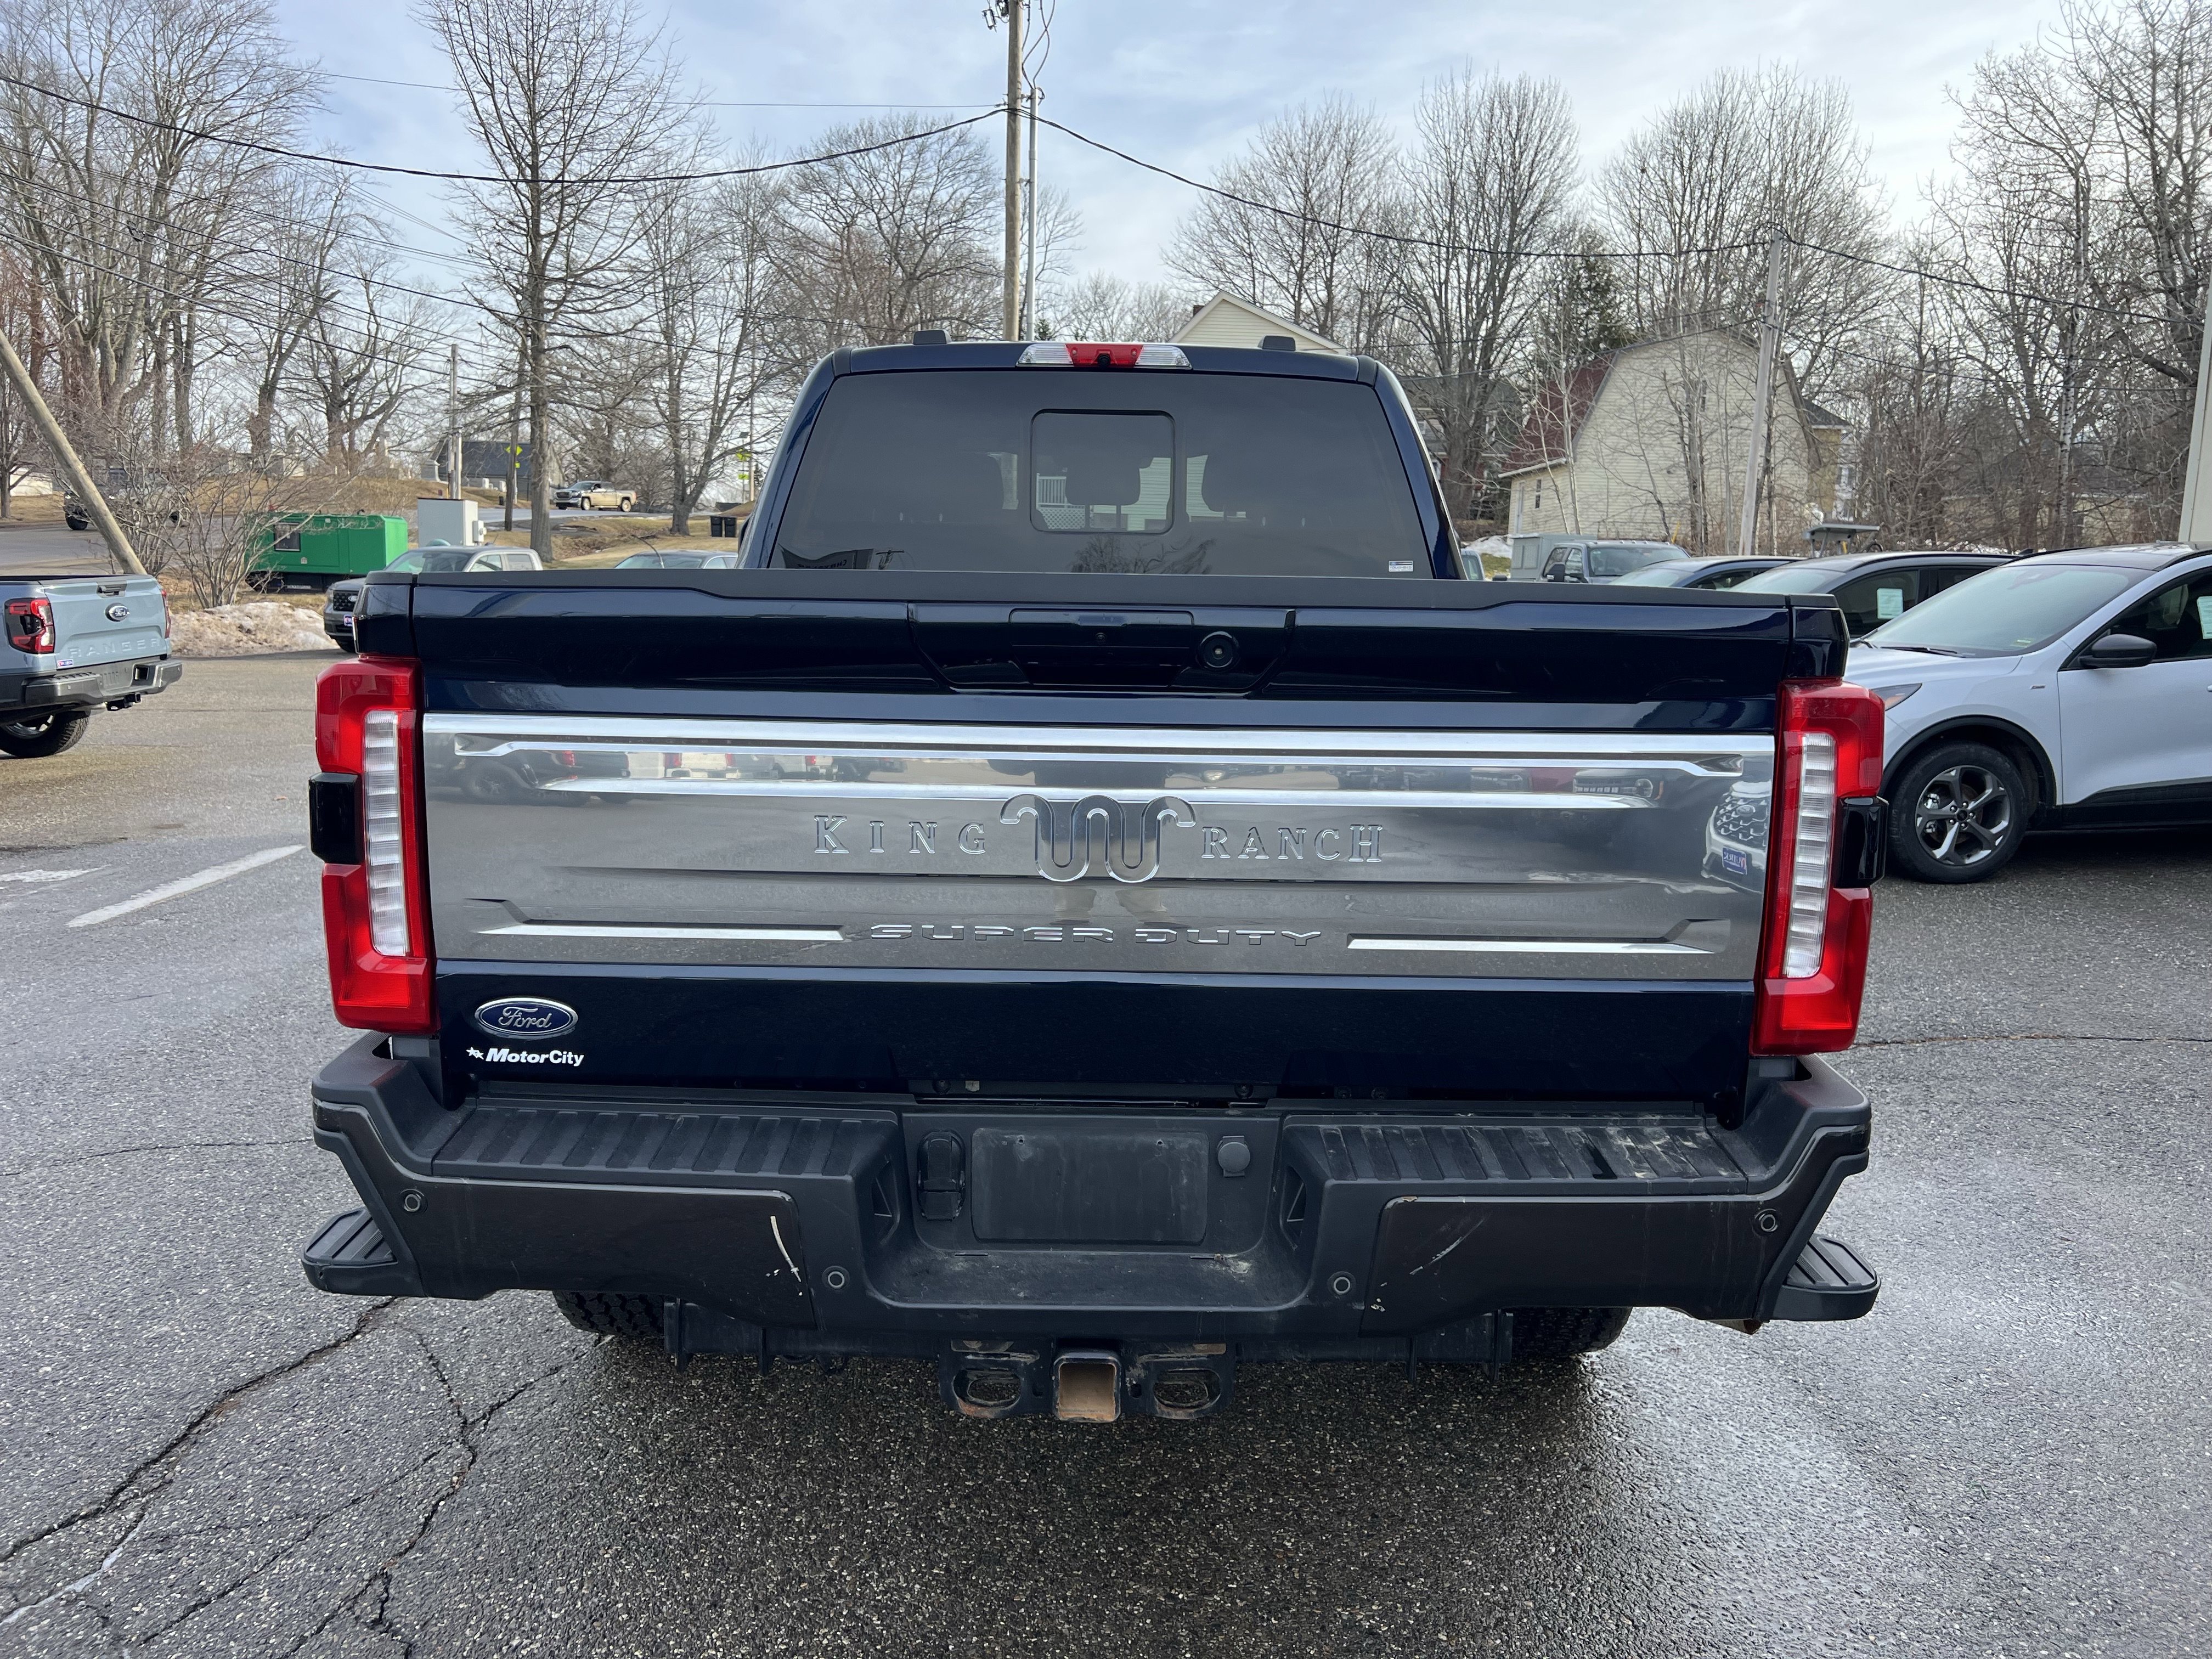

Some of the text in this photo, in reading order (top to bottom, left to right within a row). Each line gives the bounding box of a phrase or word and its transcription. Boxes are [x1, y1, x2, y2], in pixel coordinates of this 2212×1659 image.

[68, 637, 160, 658] RANGER
[814, 815, 1383, 862] KING RANCH
[871, 924, 1321, 946] SUPER DUTY
[498, 1006, 552, 1029] Ford
[485, 1048, 584, 1066] MotorCity
